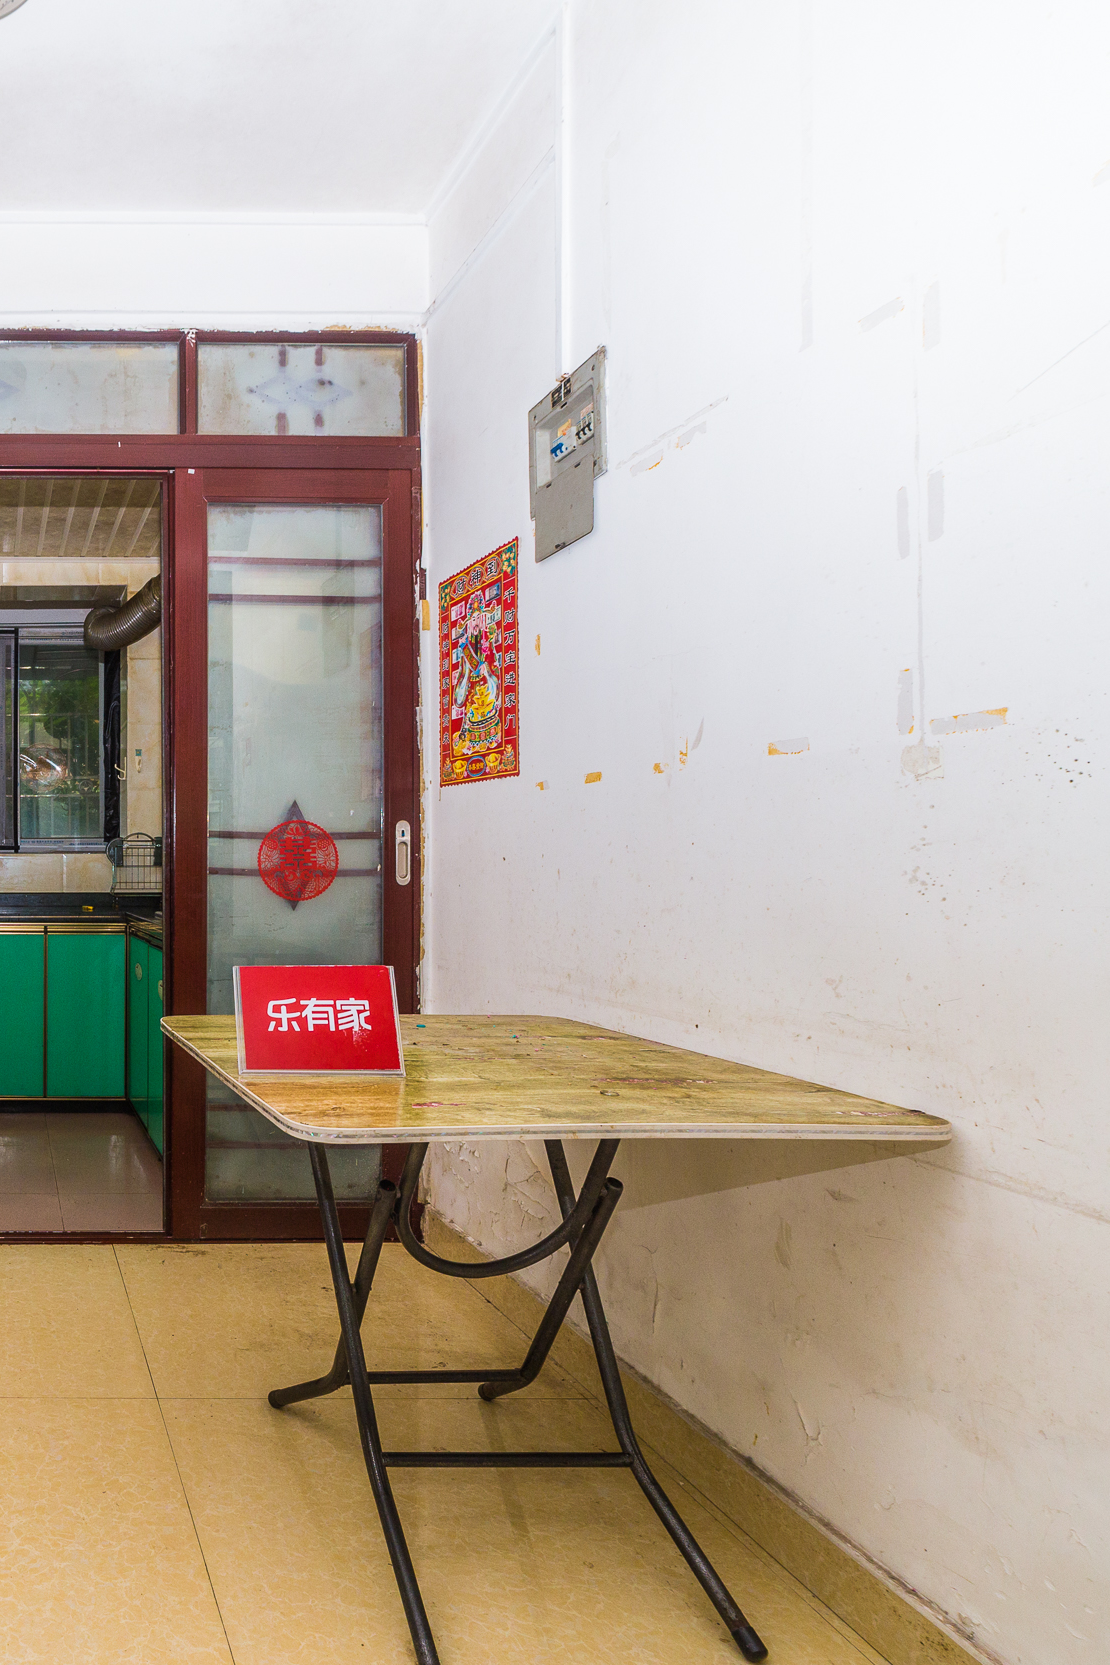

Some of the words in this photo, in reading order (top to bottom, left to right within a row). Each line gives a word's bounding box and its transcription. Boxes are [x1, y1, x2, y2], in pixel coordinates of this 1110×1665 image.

[454, 558, 498, 596] 财神到
[266, 997, 371, 1031] 乐有家
